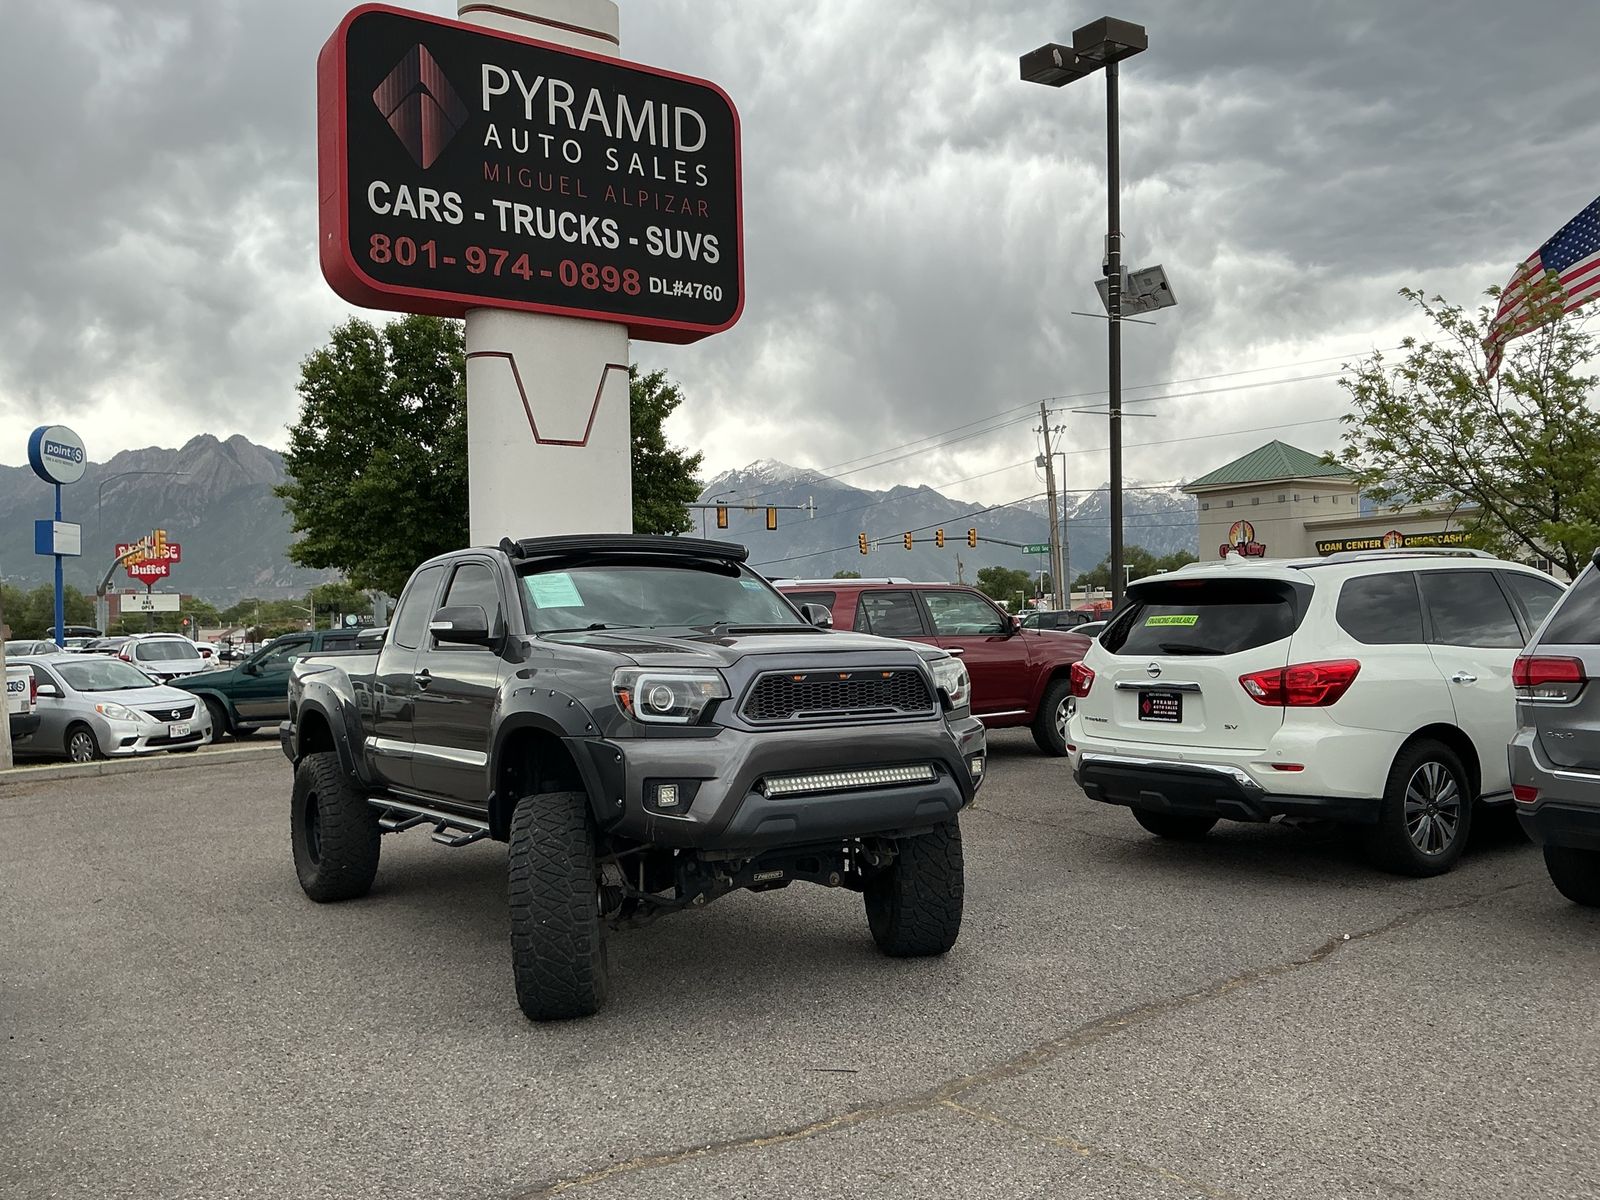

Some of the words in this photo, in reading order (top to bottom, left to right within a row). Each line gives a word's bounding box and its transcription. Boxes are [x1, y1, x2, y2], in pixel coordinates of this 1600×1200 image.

[481, 63, 707, 153] PYRAMID
[484, 123, 583, 164] AUTO
[606, 148, 709, 187] SALES
[484, 161, 588, 198] MIGUEL
[605, 185, 709, 218] ALPIZAR
[367, 180, 464, 225] CARS
[492, 200, 620, 249] TRUCKS
[646, 225, 720, 264] SUVS
[648, 276, 723, 302] DL#4760
[47, 444, 71, 457] point
[75, 449, 82, 462] S
[1319, 543, 1343, 552] LOAN
[1346, 540, 1381, 550] CENTER
[131, 564, 167, 575] Buffet
